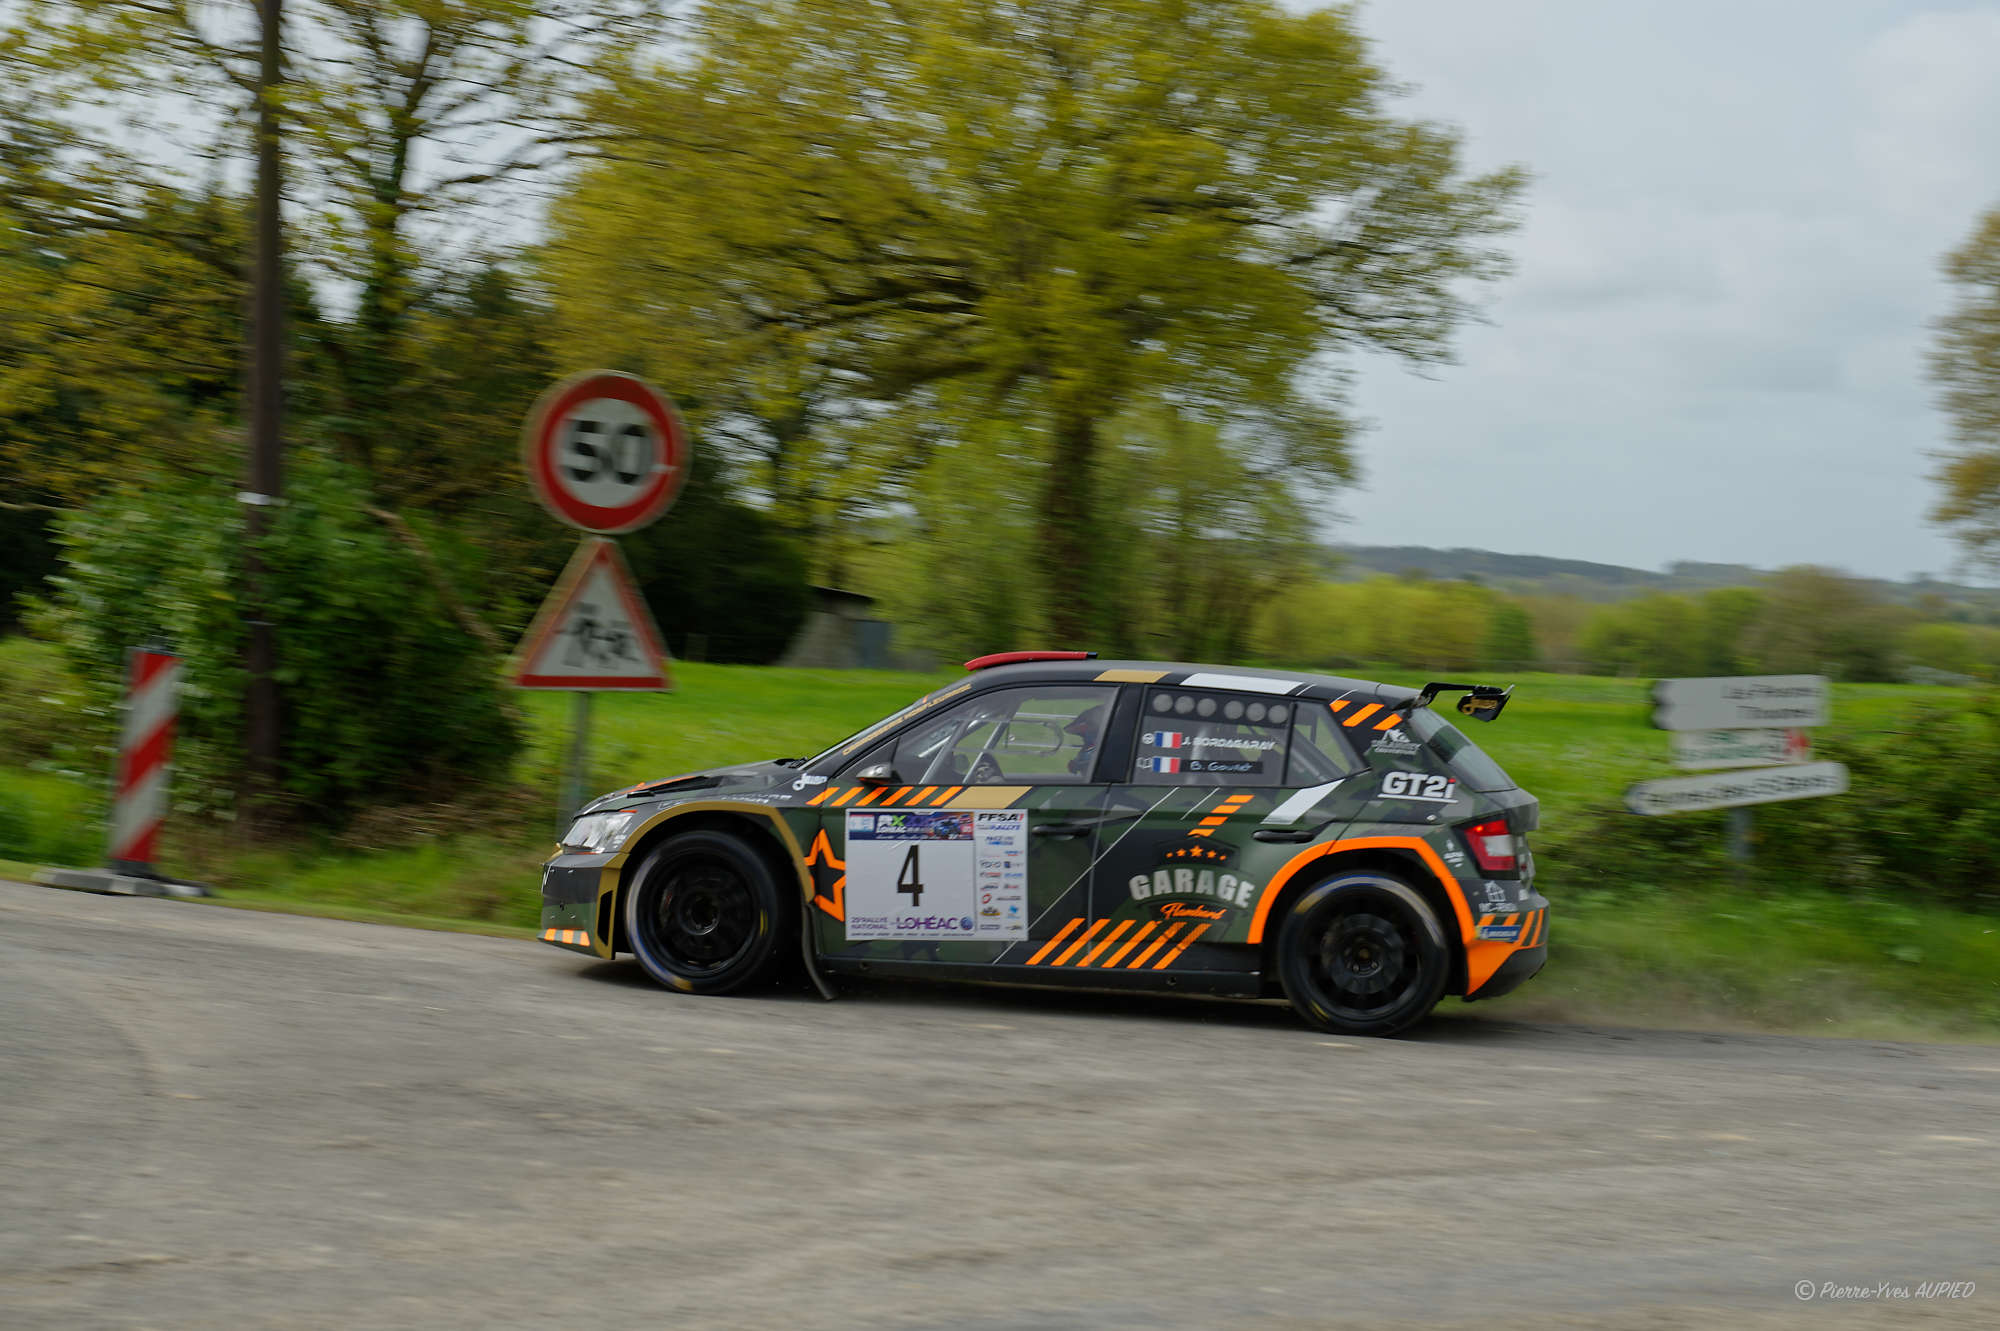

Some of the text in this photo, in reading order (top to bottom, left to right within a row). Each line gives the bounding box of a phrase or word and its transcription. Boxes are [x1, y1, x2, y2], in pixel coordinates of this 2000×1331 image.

[563, 419, 655, 485] 50
[1382, 771, 1457, 799] GT2i
[897, 844, 924, 907] 4
[1129, 868, 1255, 908] GARAGE
[896, 915, 959, 930] LOHÉAC
